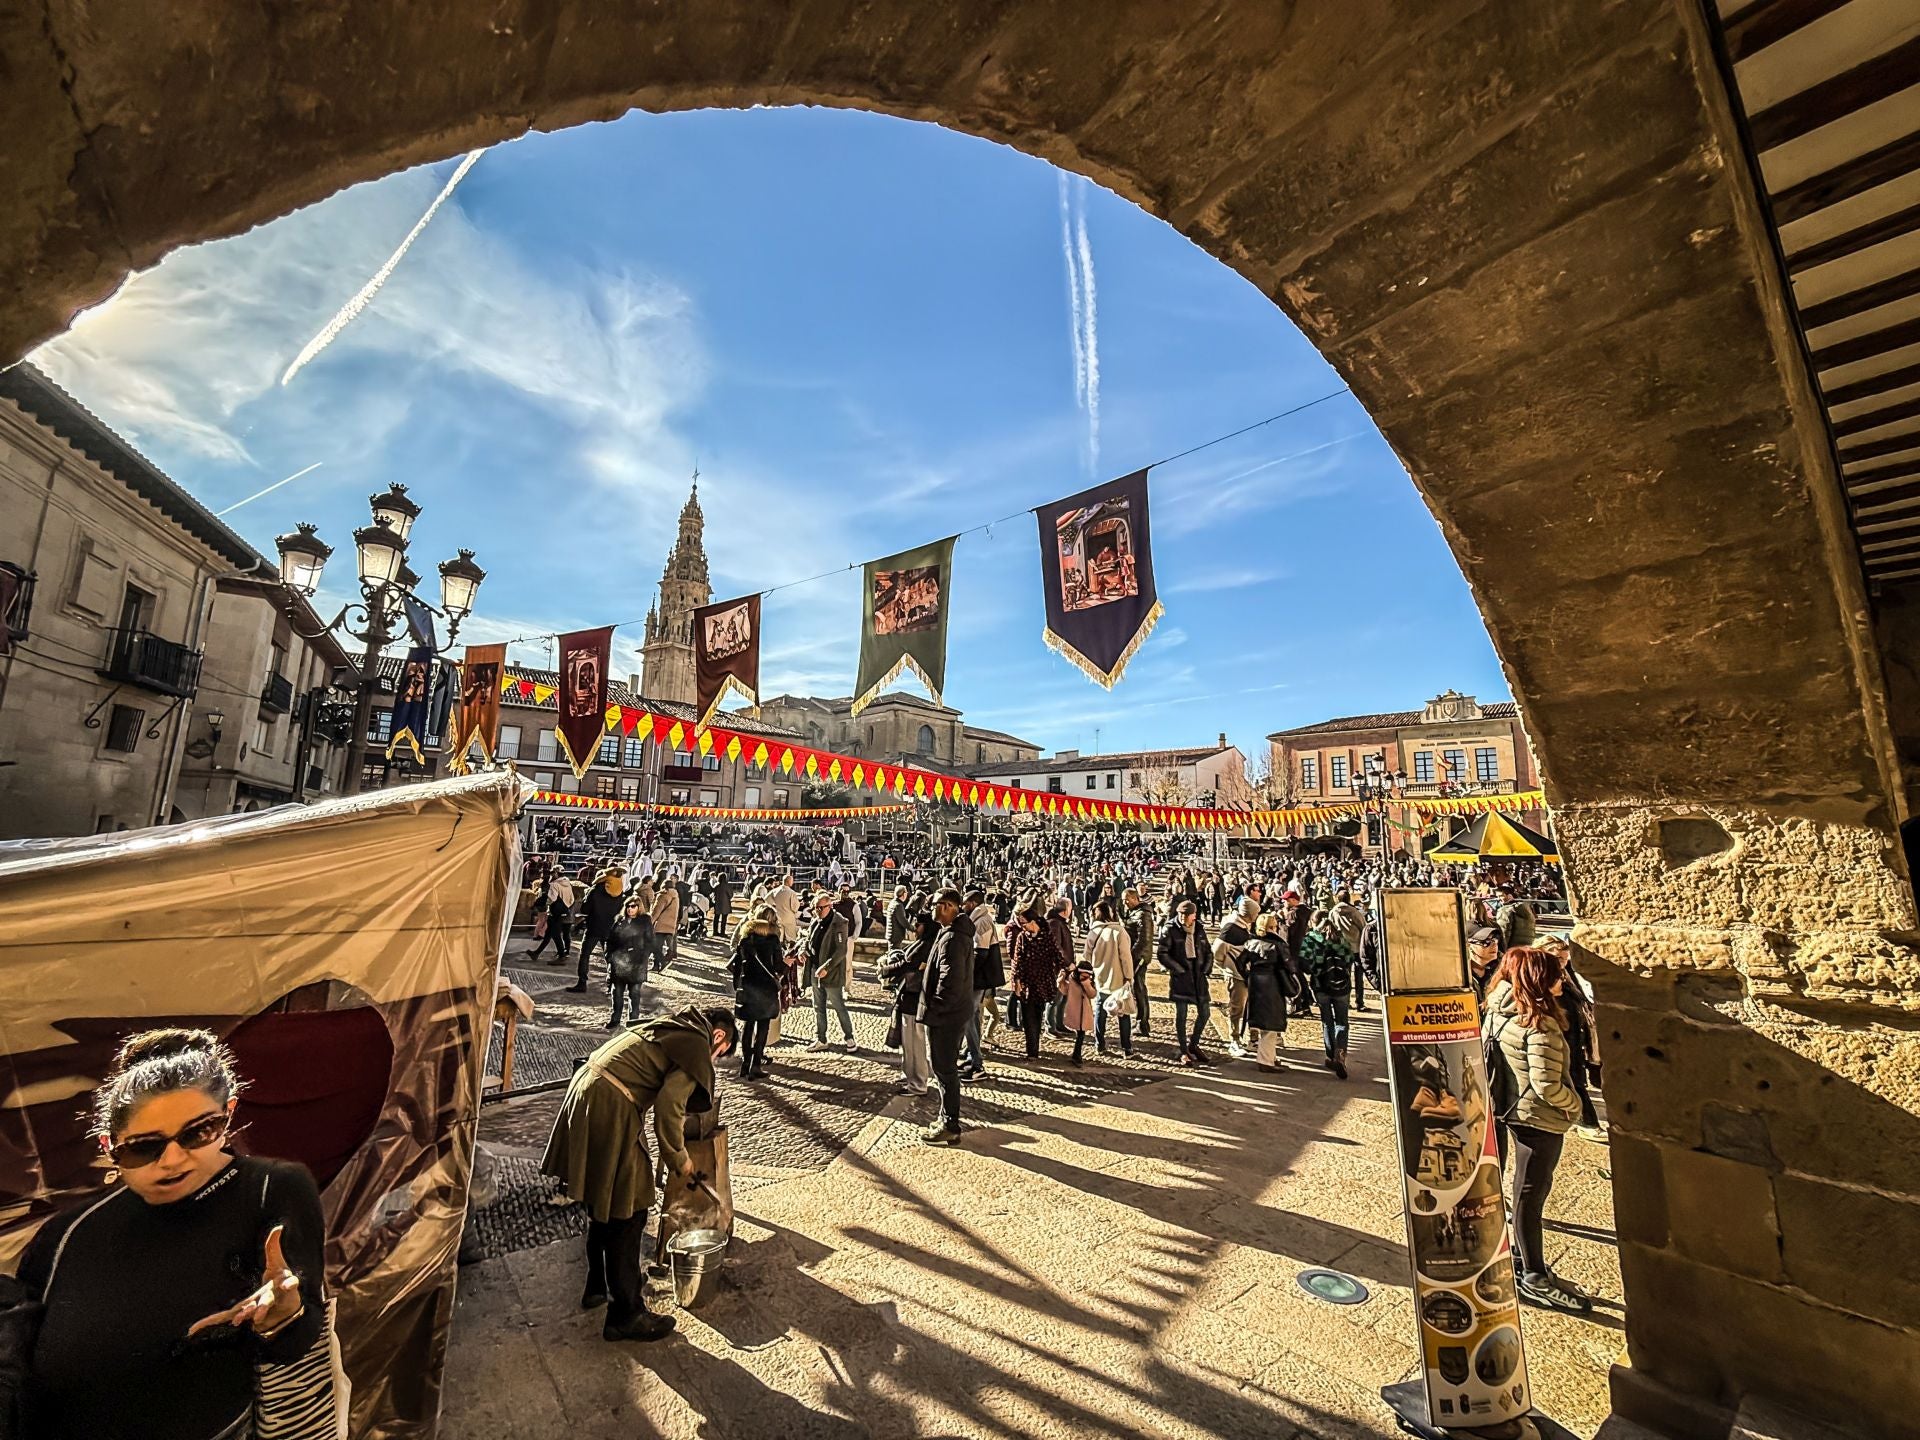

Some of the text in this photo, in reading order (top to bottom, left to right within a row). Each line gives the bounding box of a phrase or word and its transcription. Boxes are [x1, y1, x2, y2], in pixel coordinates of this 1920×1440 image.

[1415, 1000, 1465, 1014] ATENCIÓN
[1403, 1012, 1474, 1025] AL PEREGRINO
[1457, 1031, 1475, 1039] pilgrim
